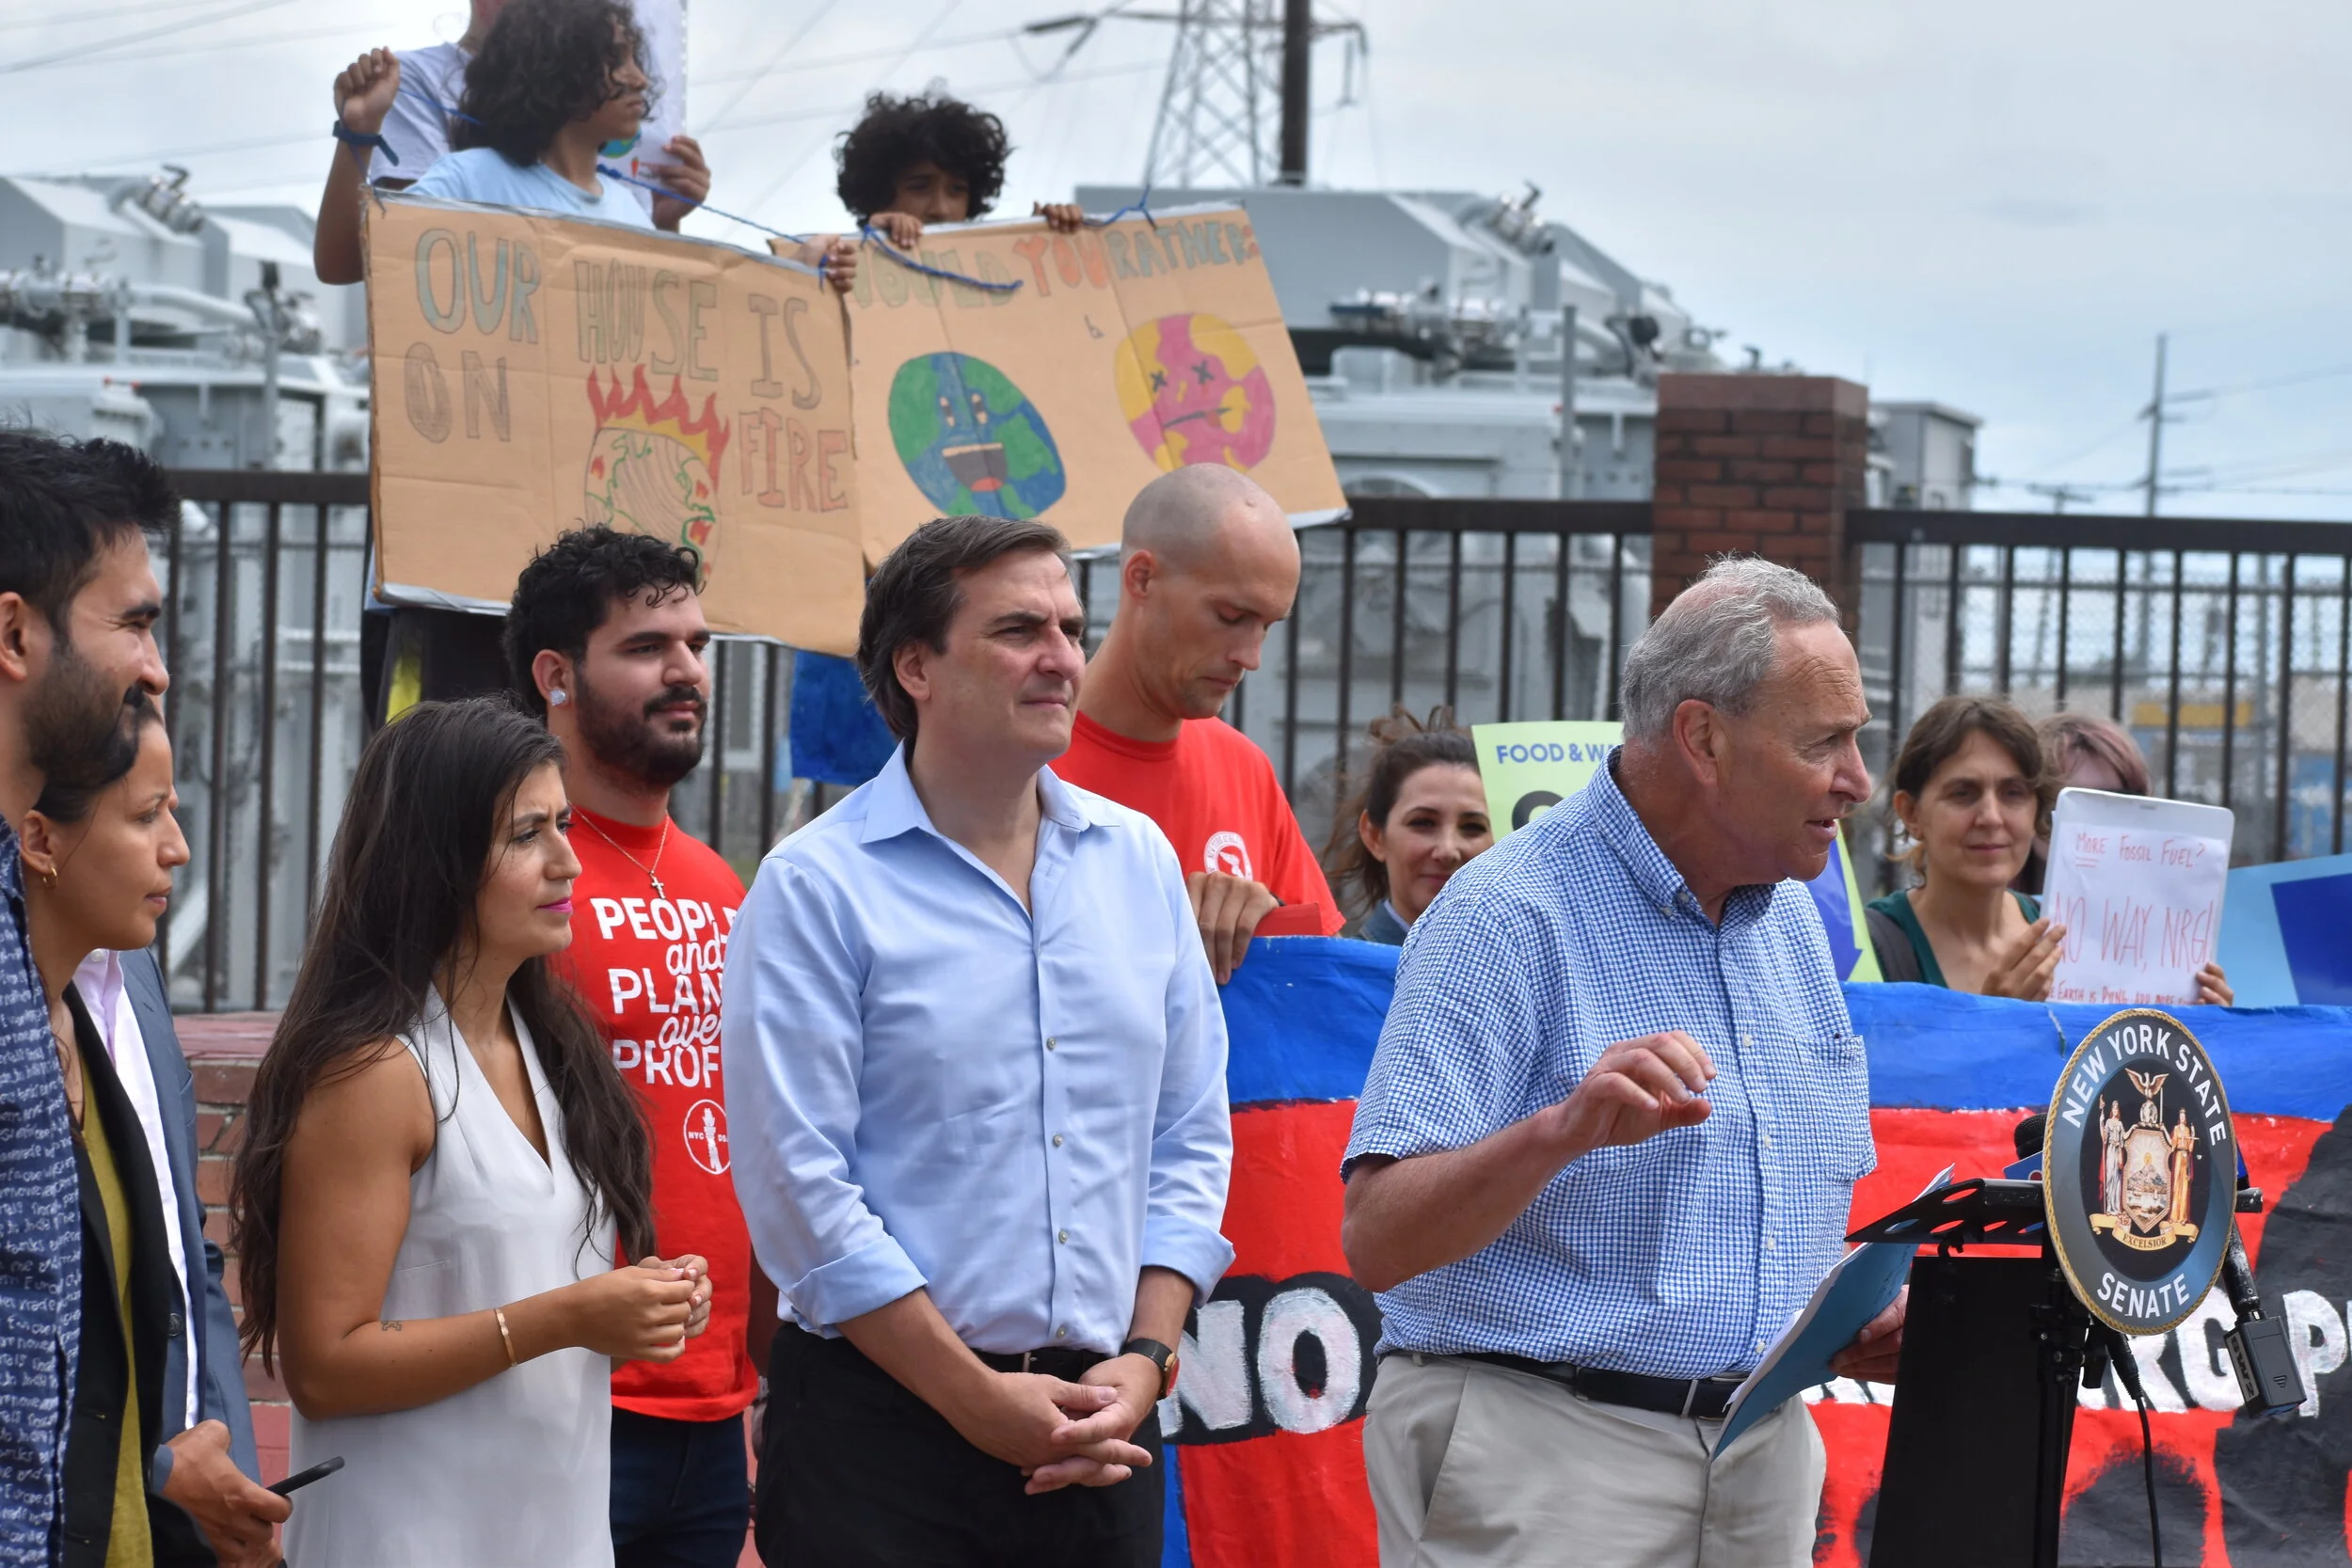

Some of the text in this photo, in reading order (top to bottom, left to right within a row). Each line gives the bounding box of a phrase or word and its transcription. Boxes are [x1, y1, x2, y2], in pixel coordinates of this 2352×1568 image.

[1012, 235, 1110, 297] YOU
[416, 228, 822, 410] OUR HOUSE IS
[405, 341, 850, 513] ON FIRE
[1496, 743, 1565, 764] FOOD
[1569, 743, 1583, 762] &
[666, 921, 724, 976] and
[2061, 1023, 2227, 1147] NEW YORK STATE
[2122, 1233, 2168, 1249] EXCELSIOR
[2097, 1272, 2190, 1320] SENATE
[1157, 1287, 1362, 1435] NO
